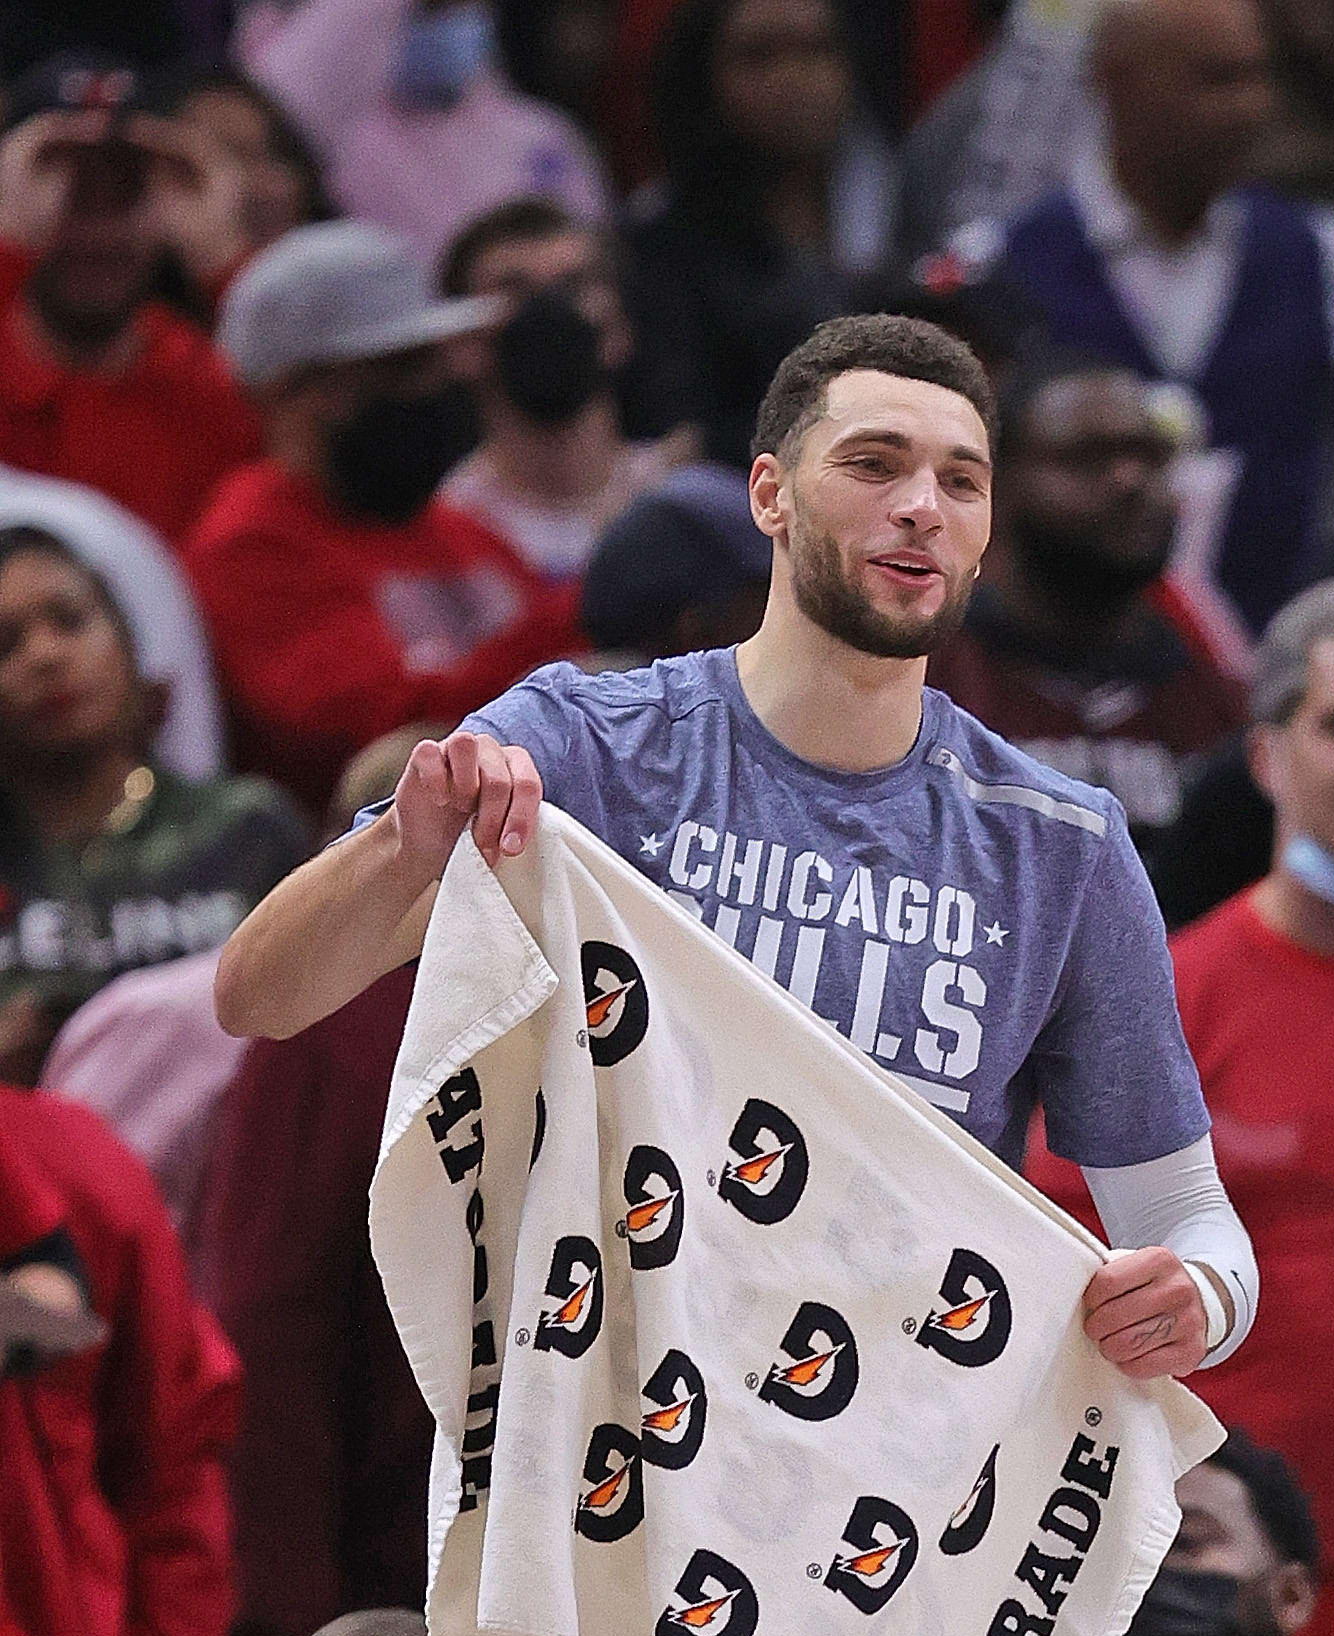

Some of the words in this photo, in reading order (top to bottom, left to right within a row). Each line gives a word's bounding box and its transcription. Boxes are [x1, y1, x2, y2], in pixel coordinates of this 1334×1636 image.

[668, 820, 977, 958] CHICAGO
[717, 1098, 810, 1226] G
[757, 1301, 860, 1422] G
[915, 1248, 1013, 1368] G
[822, 1496, 919, 1616] G
